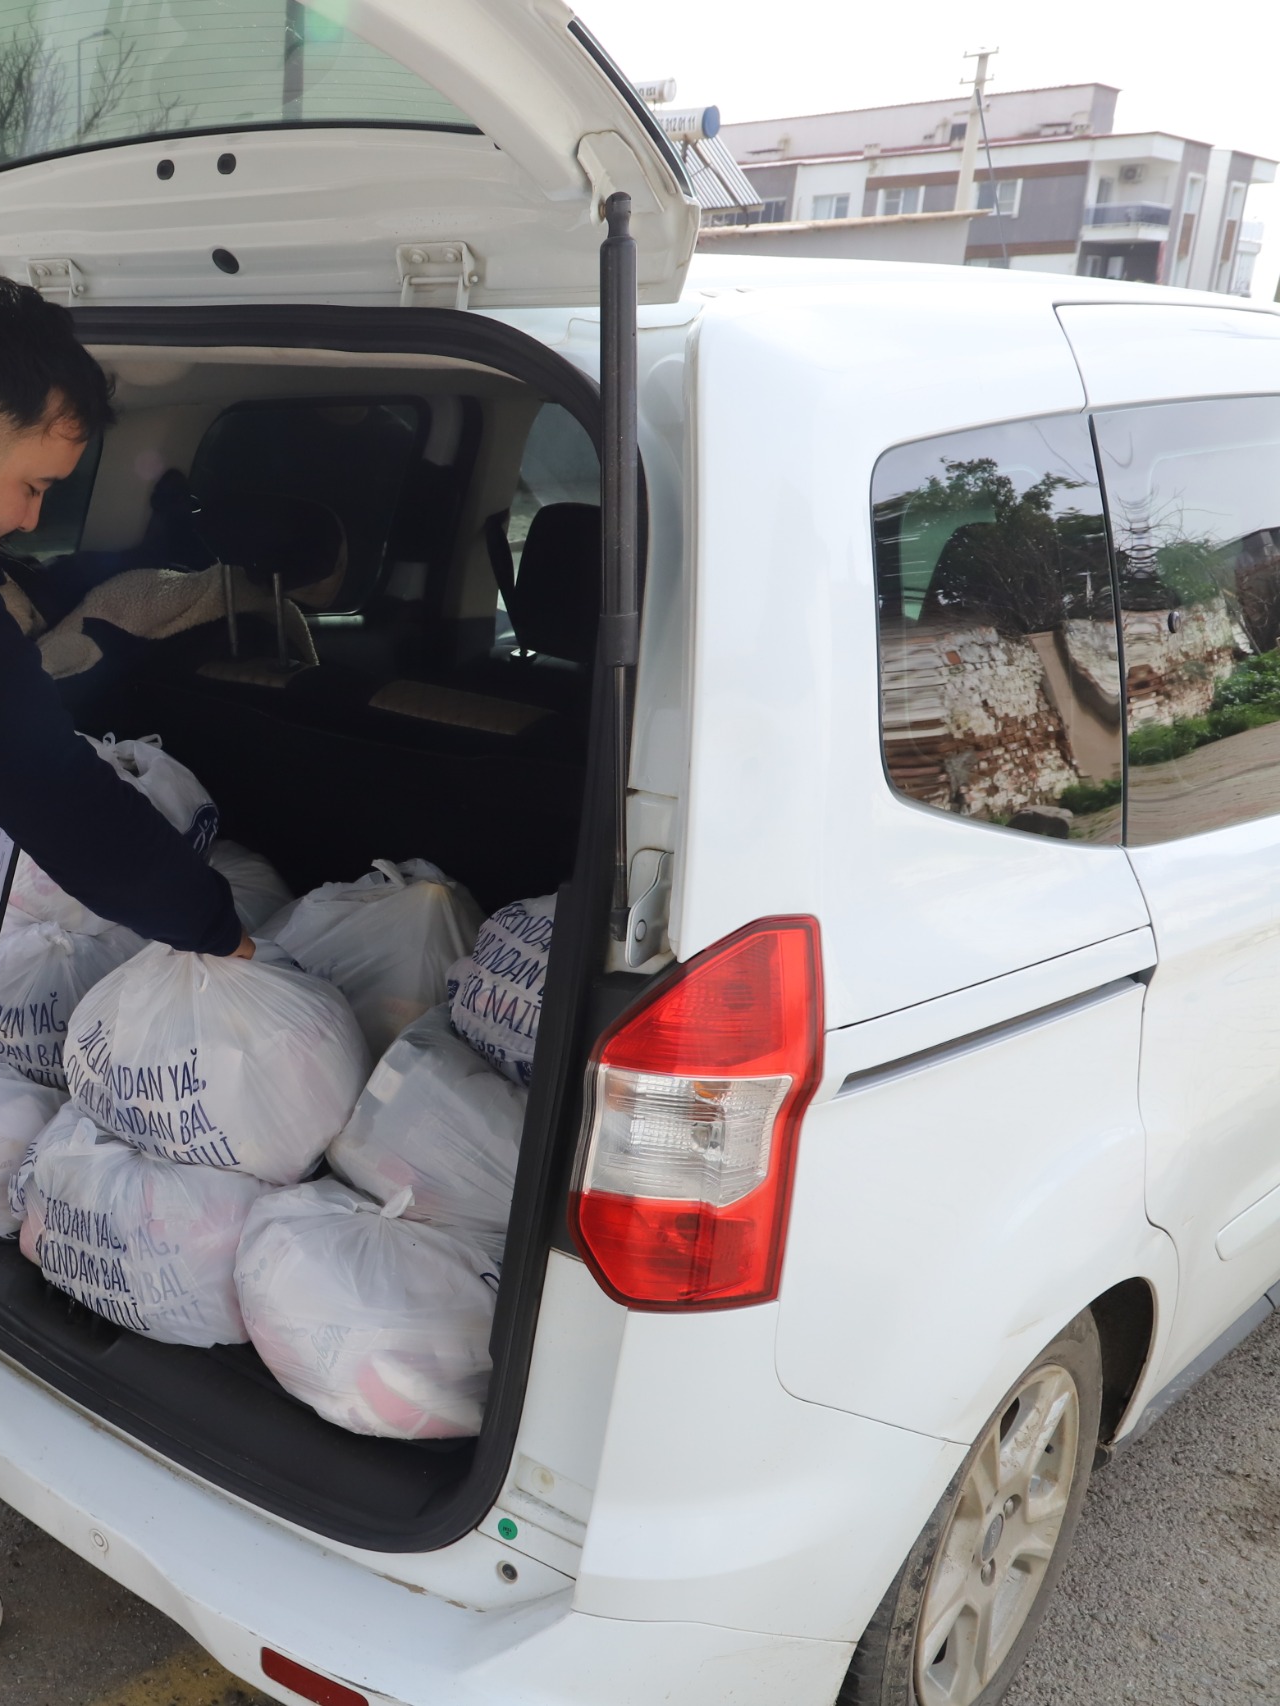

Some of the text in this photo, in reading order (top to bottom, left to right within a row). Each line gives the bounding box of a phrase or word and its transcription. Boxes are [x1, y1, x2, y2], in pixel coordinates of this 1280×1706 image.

[483, 985, 542, 1039] NAZİ
[37, 1041, 64, 1069] BA
[179, 1099, 218, 1145] BAL
